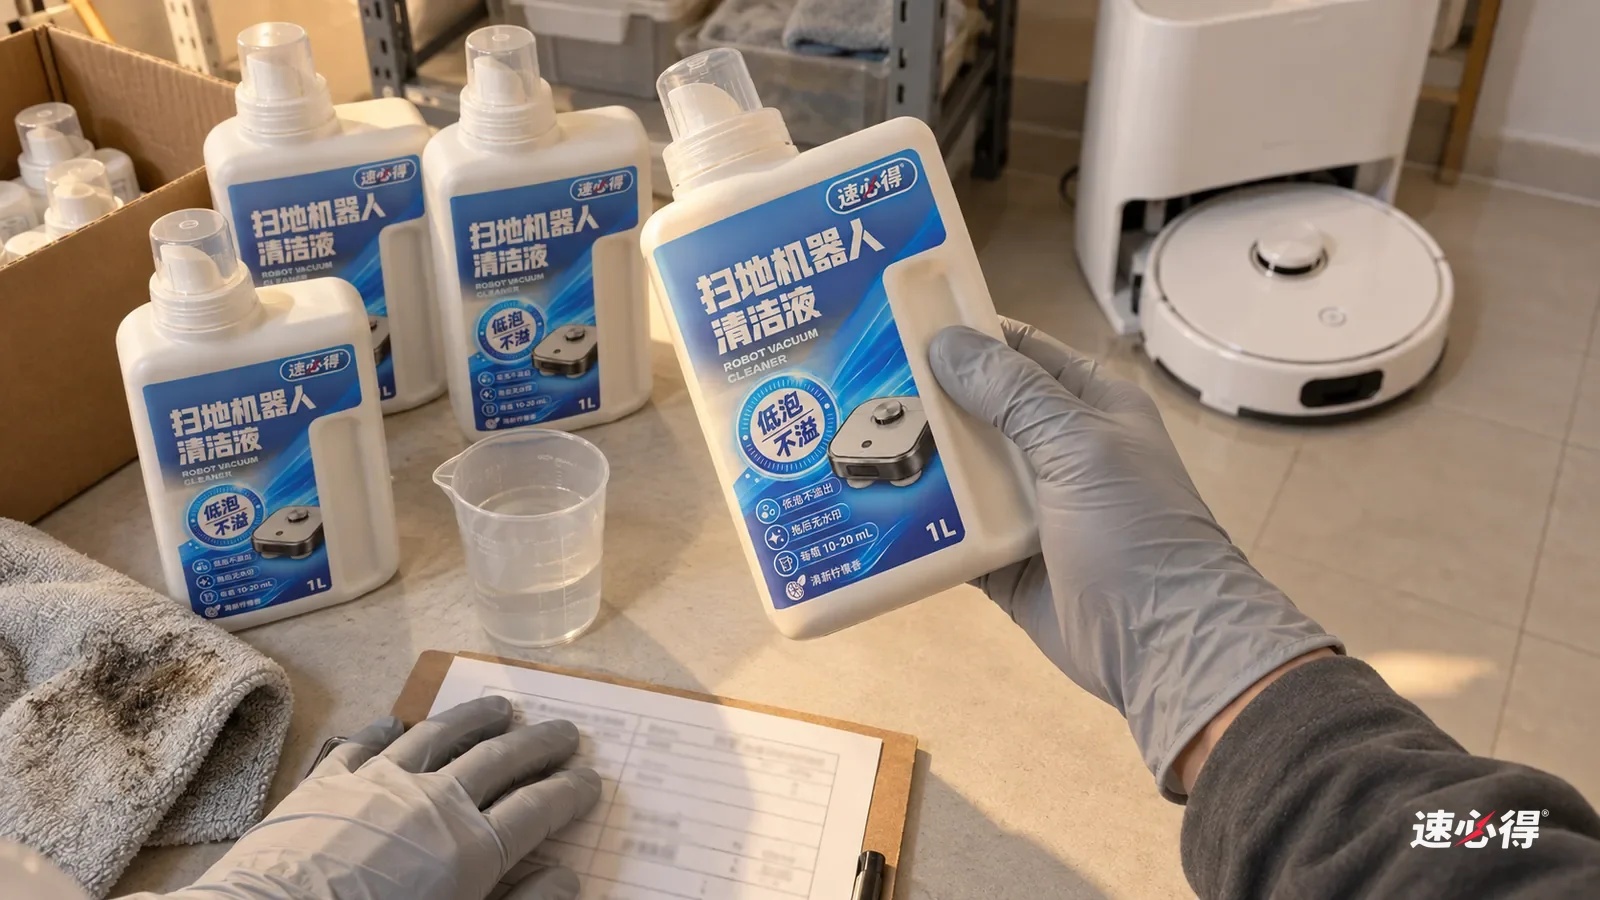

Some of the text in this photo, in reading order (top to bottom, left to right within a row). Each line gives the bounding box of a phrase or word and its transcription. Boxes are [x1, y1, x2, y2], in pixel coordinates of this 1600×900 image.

[251, 193, 386, 238] 扫地机器人
[469, 205, 599, 250] 扫地机器人
[257, 231, 336, 266] 清洁液
[474, 244, 548, 278] 清洁液
[262, 261, 333, 278] ROBOT VACUUM
[696, 218, 885, 314] 扫地机器人
[475, 280, 506, 290] ROBOT
[492, 311, 524, 335] 低泡
[711, 285, 822, 355] 清洁液
[500, 329, 530, 350] 不溢
[723, 328, 819, 372] ROBOT VACUUM
[728, 354, 787, 383] CLEANER
[169, 385, 316, 437] 扫地机器人
[579, 398, 596, 410] 1L
[757, 391, 803, 435] 低泡
[176, 426, 262, 465] 清洁液
[774, 416, 820, 457] 不溢
[182, 456, 259, 478] ROBOT VACUUM
[184, 471, 232, 486] CLEANER
[204, 495, 240, 521] 低泡
[214, 511, 249, 536] 不溢
[926, 519, 956, 542] 1L
[822, 535, 853, 555] 10-20
[855, 528, 873, 545] mL
[307, 578, 326, 591] 1L
